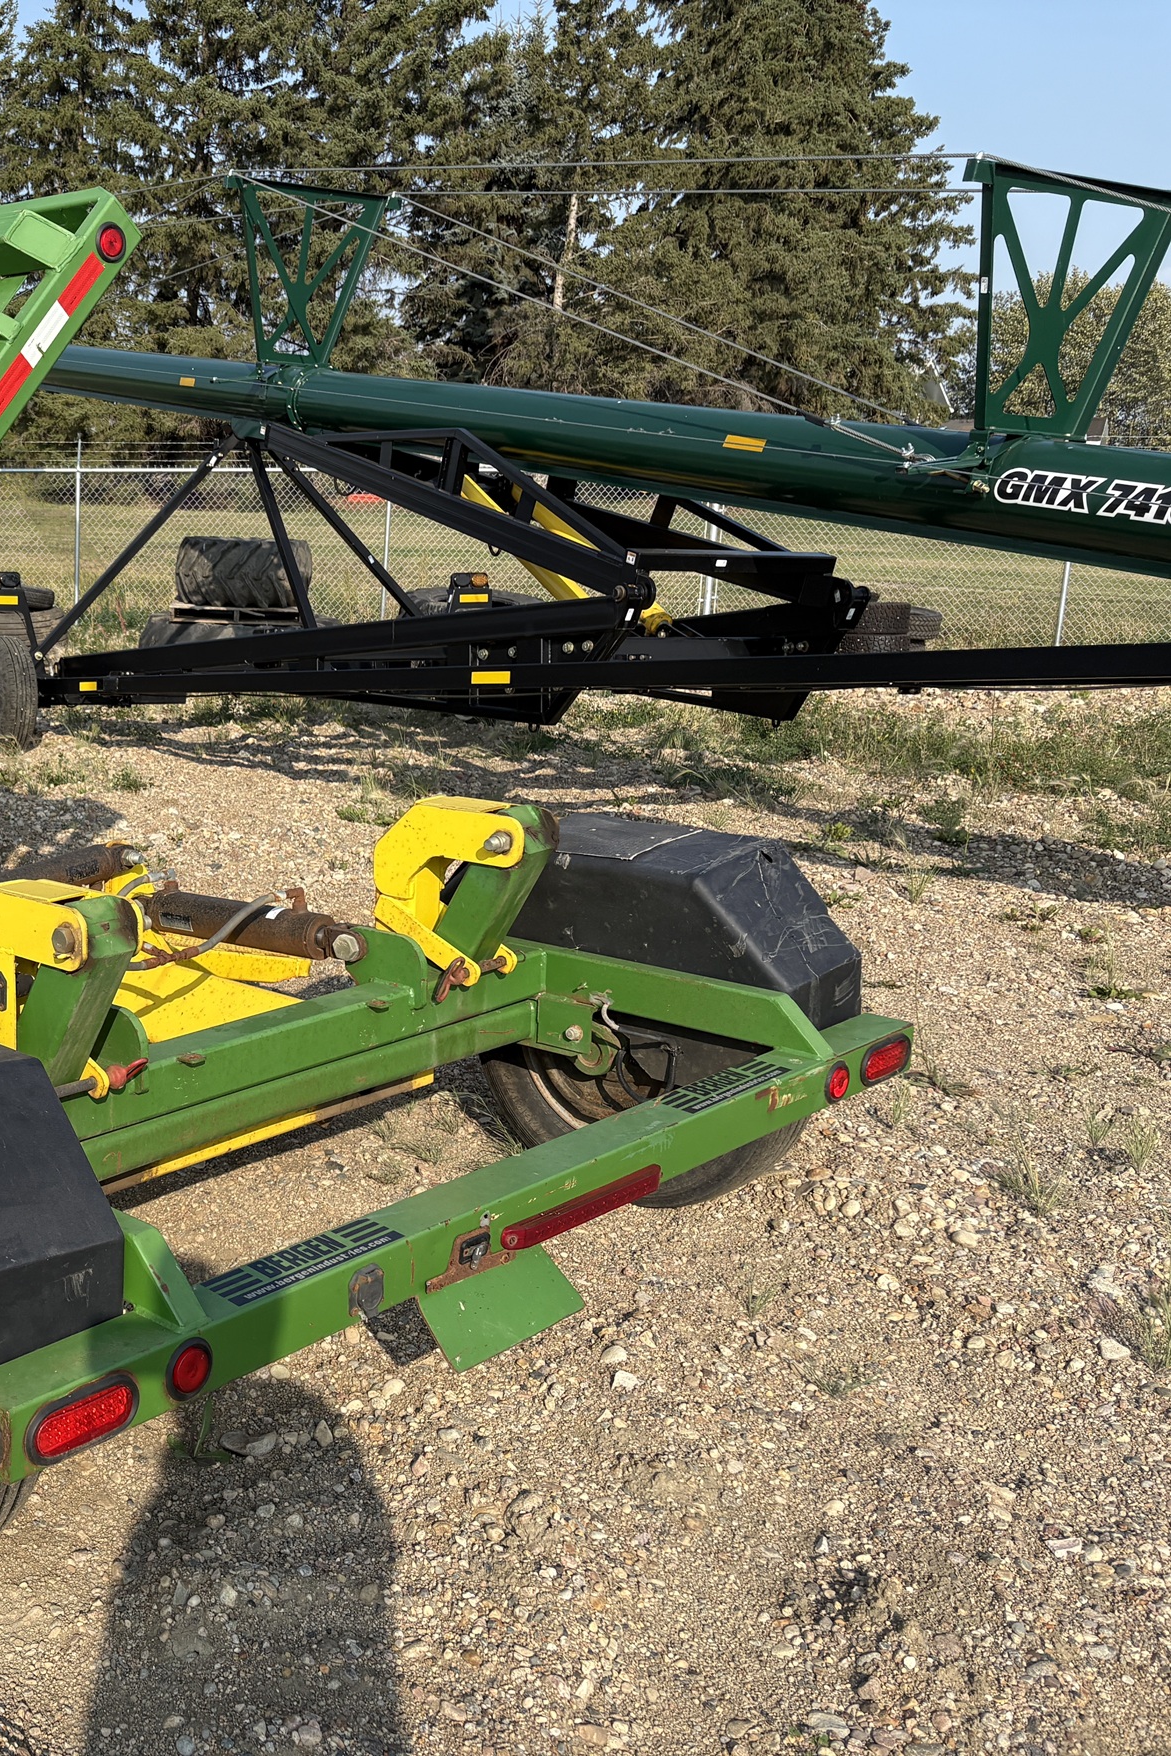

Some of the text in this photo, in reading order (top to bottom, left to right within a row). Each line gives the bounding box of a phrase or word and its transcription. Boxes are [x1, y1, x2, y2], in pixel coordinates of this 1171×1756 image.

[995, 468, 1171, 524] GMX 741
[682, 1069, 750, 1096] BERGEN
[248, 1234, 347, 1278] BERGEN
